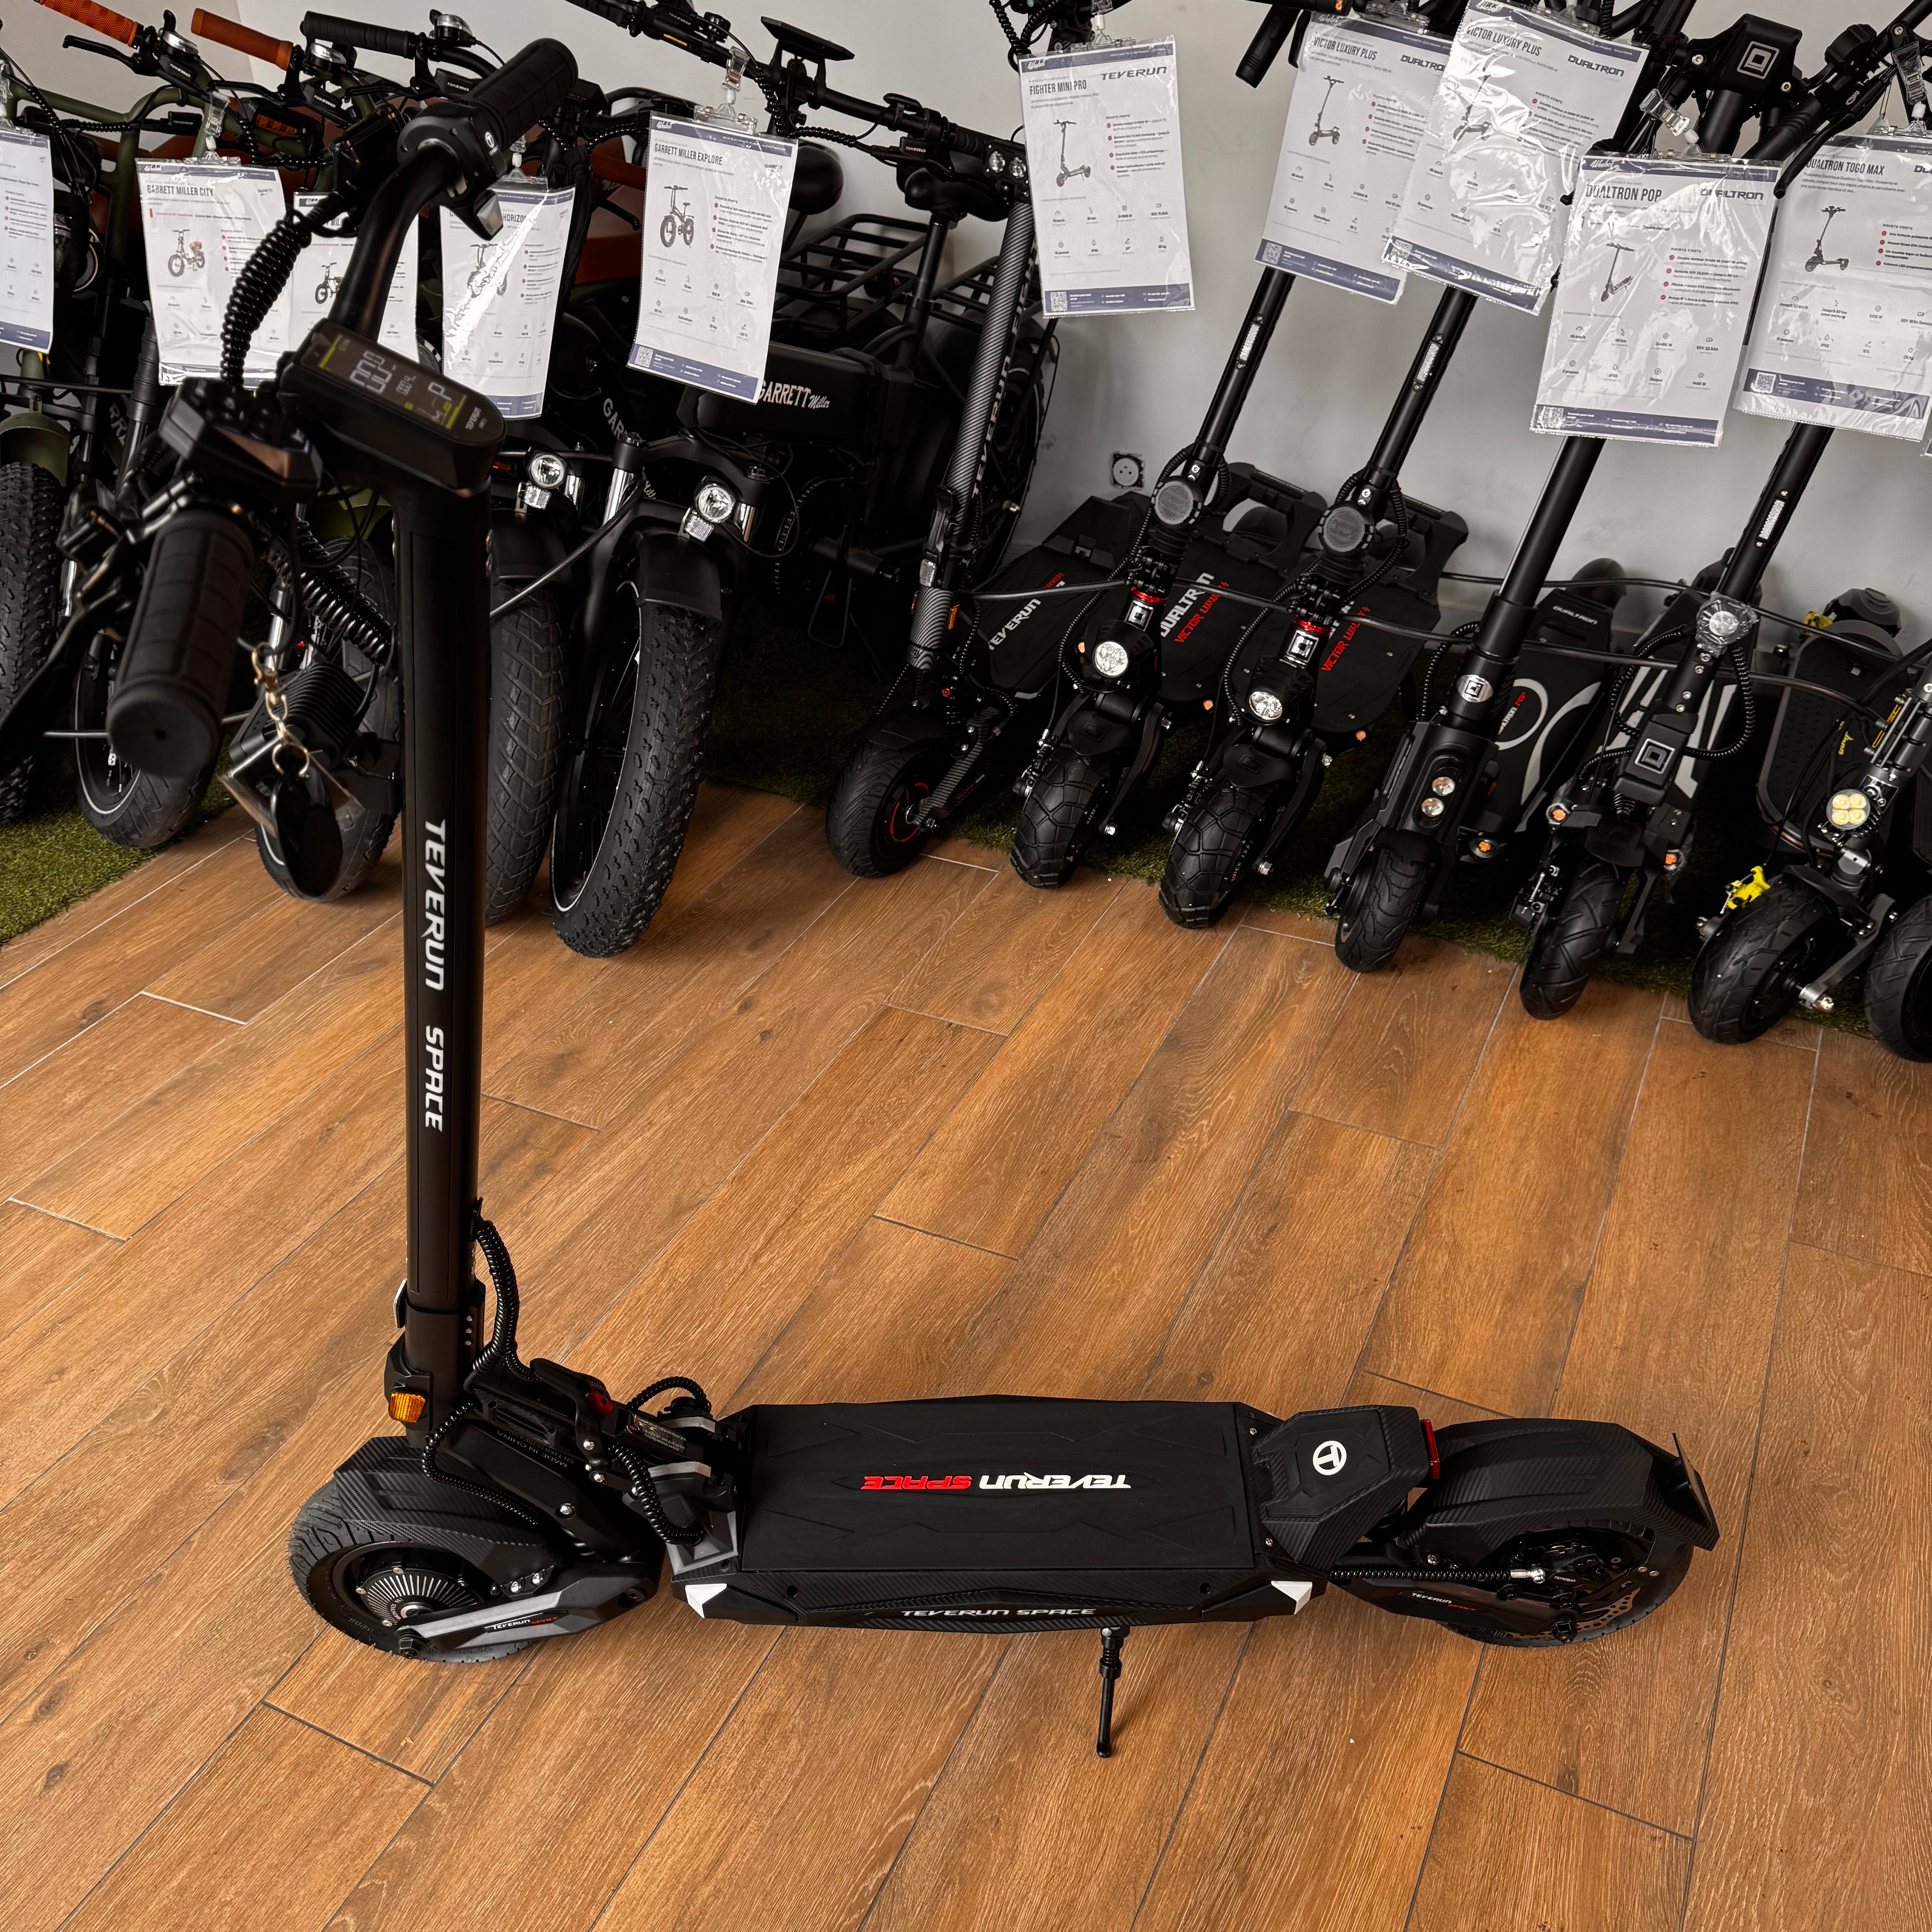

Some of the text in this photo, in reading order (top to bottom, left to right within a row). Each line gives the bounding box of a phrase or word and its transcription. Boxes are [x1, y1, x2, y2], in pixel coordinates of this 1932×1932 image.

[1313, 37, 1336, 50] VICTOR
[1336, 42, 1360, 56] LUXURY
[1360, 49, 1377, 60] PLUS
[1466, 26, 1542, 56] VICTOR LUXURY PLUS
[1401, 55, 1446, 71] DUALTRO
[1568, 55, 1624, 77] DUALTRON
[1101, 66, 1167, 80] TEVERUN
[1030, 80, 1086, 95] FIGHTER MINI PRO
[655, 143, 723, 165] GARRETT MILLER EXPLORE
[1806, 159, 1885, 175] DUALTRON TOGO MAX
[147, 185, 213, 196] GARRETT MILLER CITY
[1585, 184, 1662, 202] DUALTRON POP
[1174, 613, 1205, 643] VICTOR
[1320, 640, 1350, 672] VICTOR
[421, 819, 446, 1133] TEVERUN SPACE
[497, 1430, 568, 1468] MADE IN CHINA
[861, 1472, 1131, 1490] TEVERUN SPACE
[1412, 1592, 1452, 1604] TEVERUN
[493, 1619, 530, 1630] TEVERUN
